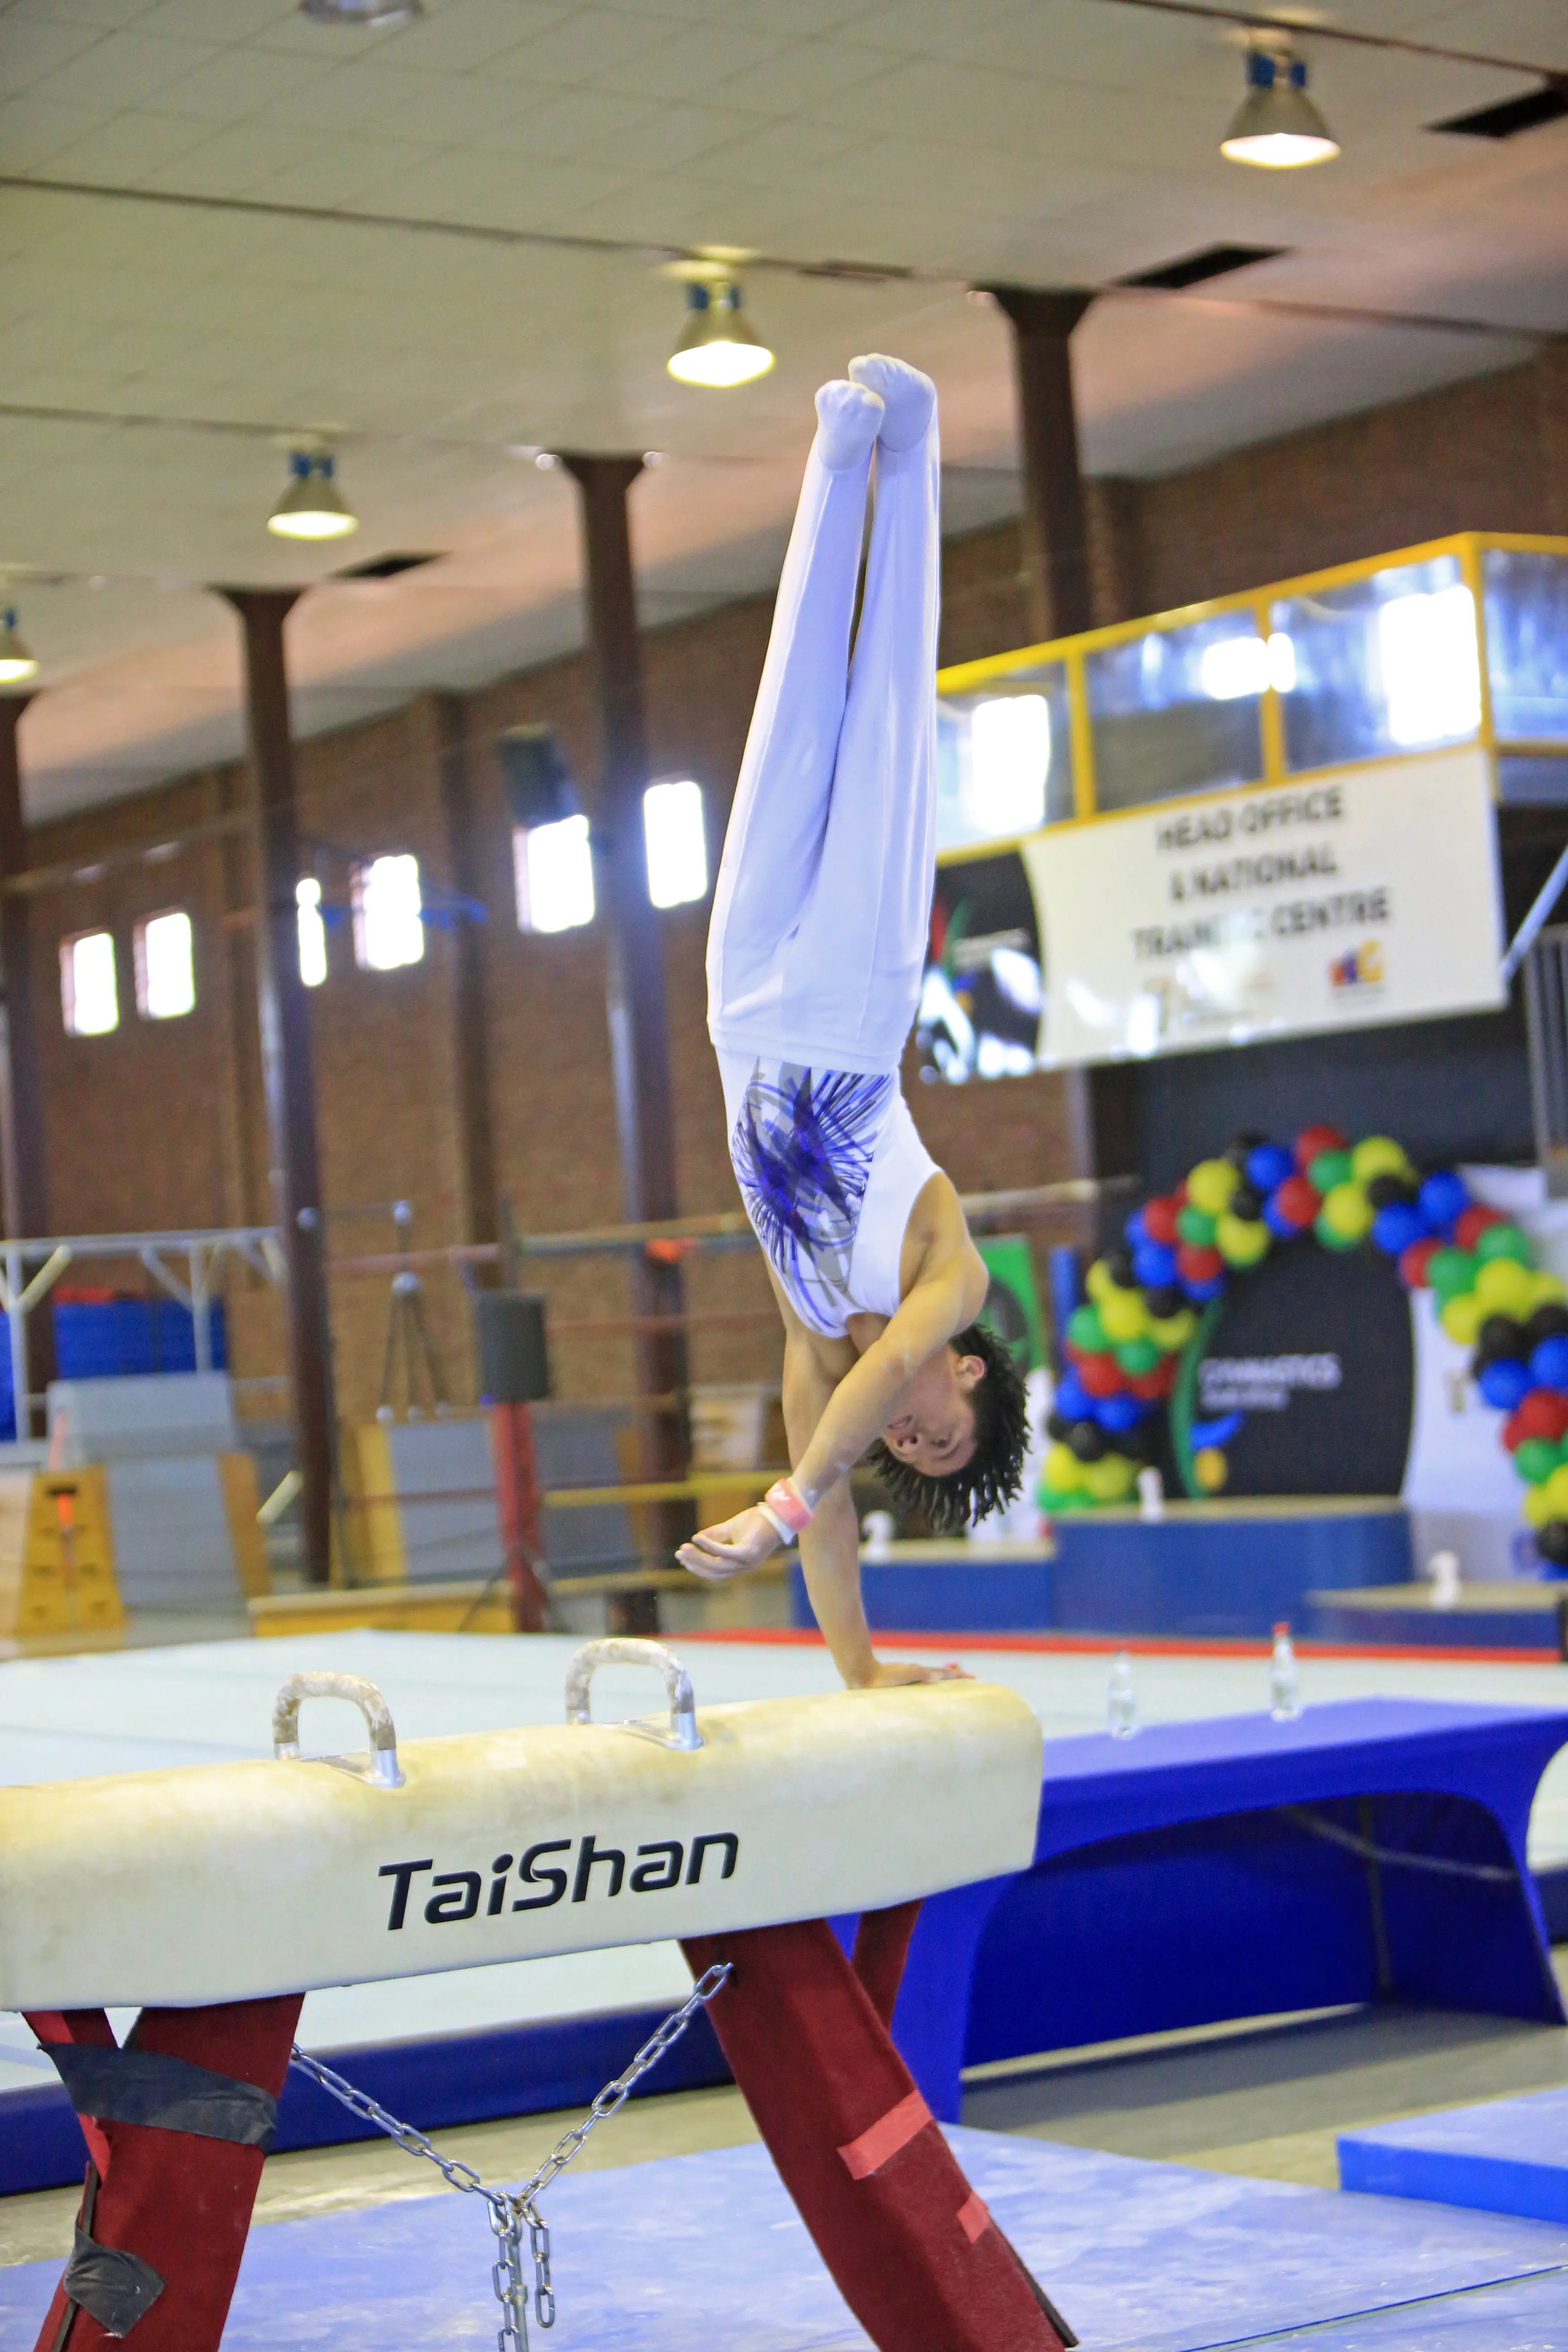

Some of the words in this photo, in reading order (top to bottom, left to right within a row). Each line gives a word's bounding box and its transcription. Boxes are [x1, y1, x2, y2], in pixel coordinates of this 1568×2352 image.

[1155, 809, 1233, 849] HEAD
[1238, 785, 1343, 834] OFFICE
[1193, 842, 1338, 895] NATIONAL
[1271, 888, 1391, 938] CENTRE
[378, 1832, 739, 1931] TaiShan
